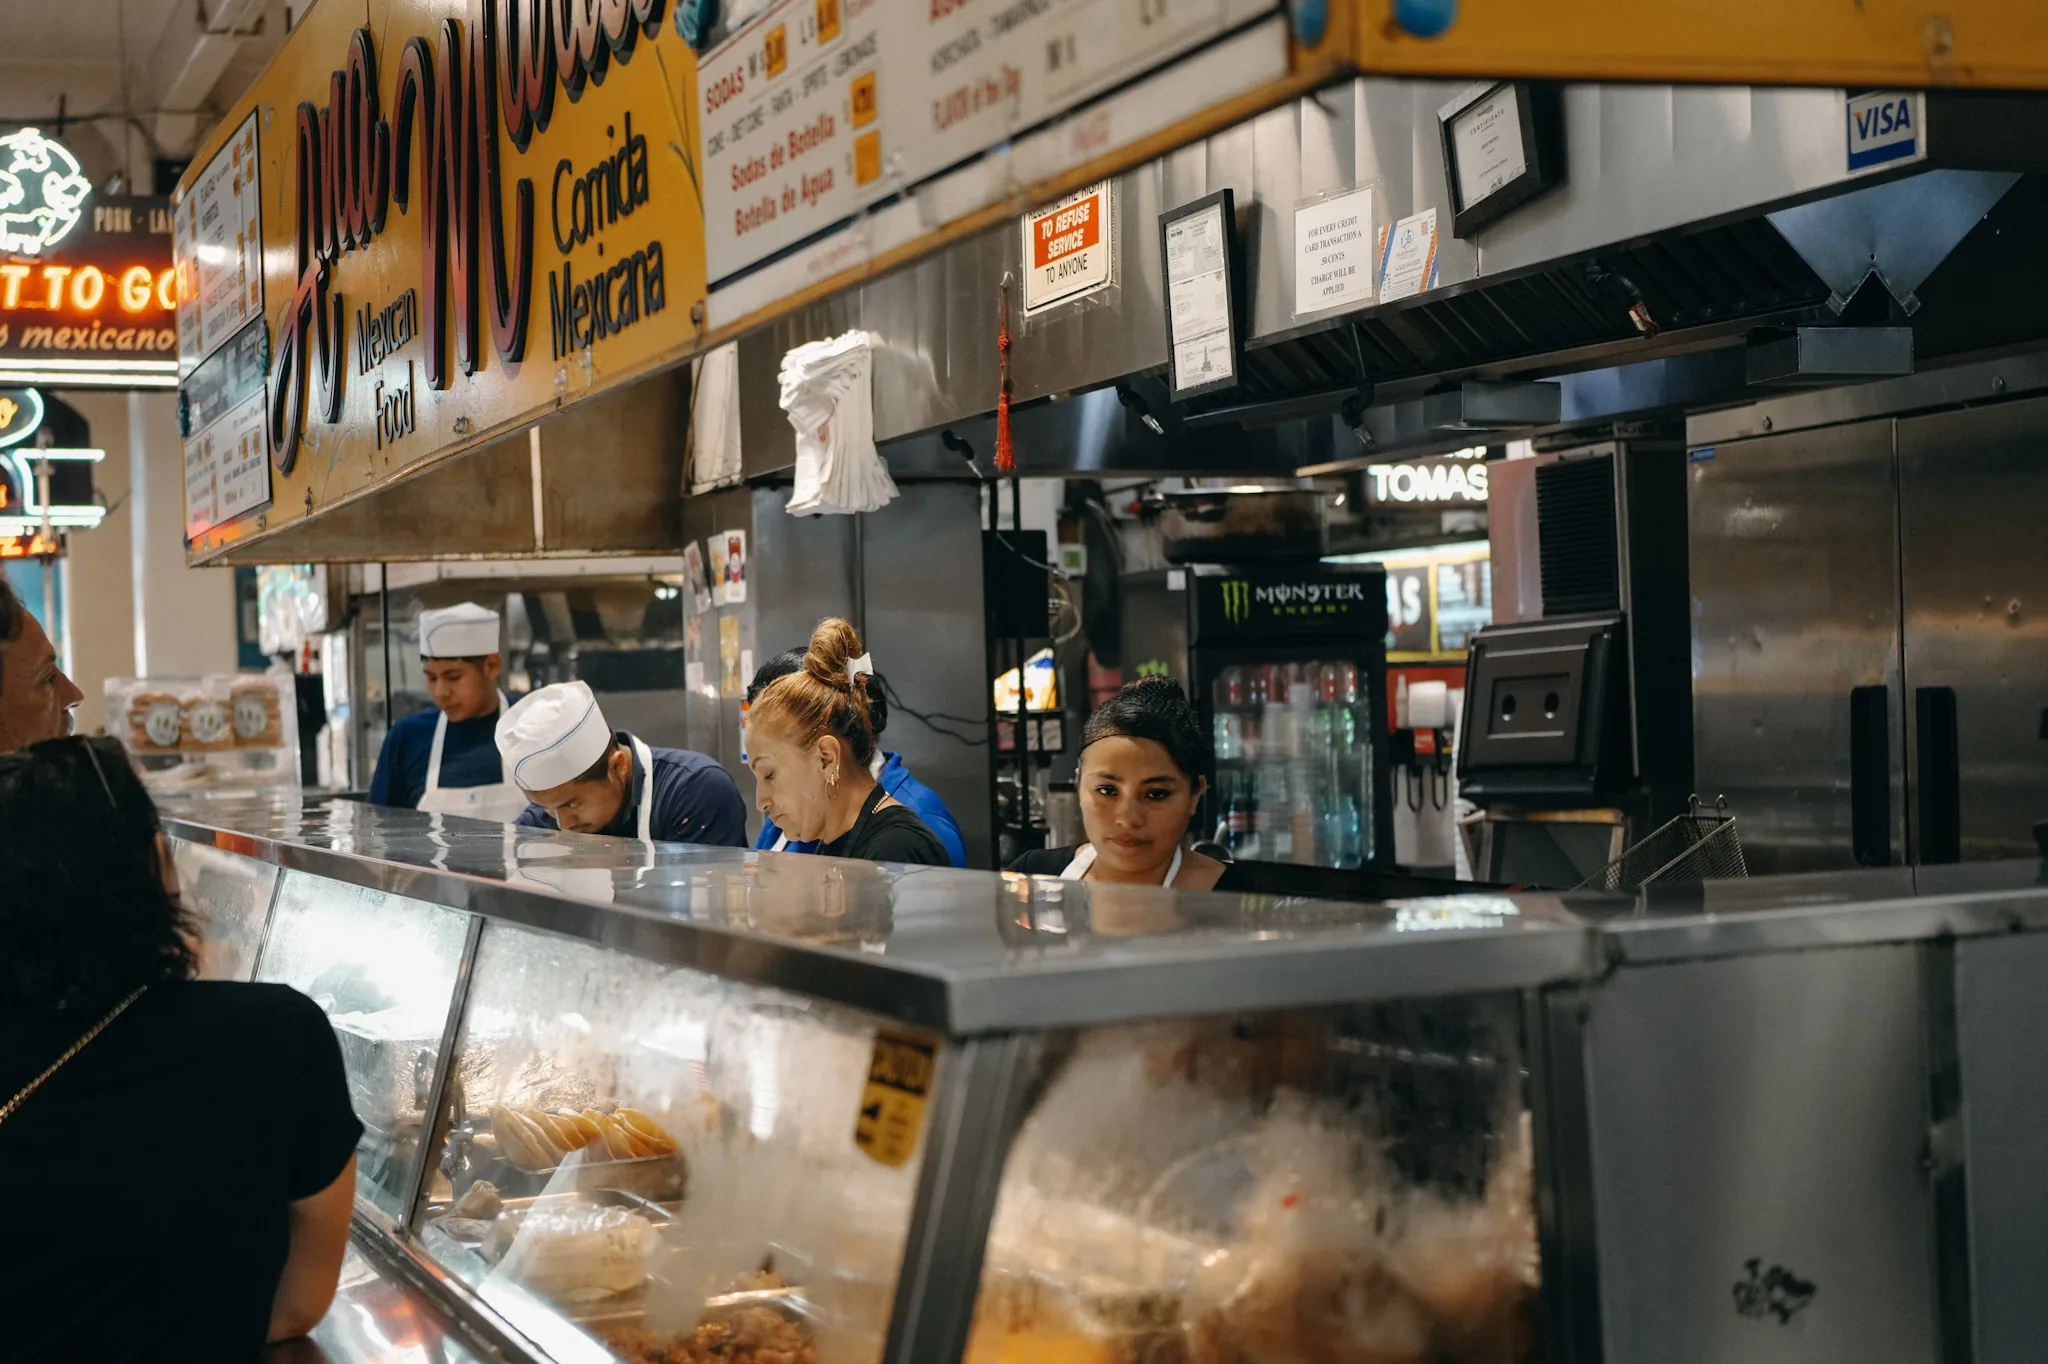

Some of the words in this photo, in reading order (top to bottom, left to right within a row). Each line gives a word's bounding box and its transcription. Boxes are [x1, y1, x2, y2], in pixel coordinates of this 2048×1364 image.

[706, 65, 744, 115] SODAS
[1853, 98, 1910, 140] VISA
[731, 156, 767, 192] Sodas
[770, 139, 785, 170] de
[788, 113, 835, 160] Botella
[551, 110, 649, 254] Comida
[735, 197, 776, 237] Botella
[782, 183, 796, 213] de
[802, 168, 834, 207] Agua
[1041, 219, 1053, 240] TO
[1055, 202, 1091, 234] REFUSE
[1047, 228, 1084, 260] SERVICE
[1304, 242, 1319, 254] CARD
[1320, 231, 1357, 249] TRANSACTION
[1308, 228, 1319, 239] FOR
[1319, 222, 1337, 235] EVERY
[1338, 216, 1358, 230] CREDIT
[1046, 266, 1055, 284] TO
[1058, 253, 1087, 280] ANYONE
[1311, 271, 1332, 285] CHARGE
[1333, 267, 1347, 278] WILL
[1348, 265, 1356, 275] BE
[1328, 251, 1345, 264] CENTS
[43, 265, 104, 310] TO
[549, 239, 666, 361] Mexicana
[1322, 282, 1345, 296] APPLIED
[356, 288, 417, 376] Mexican
[374, 360, 417, 450] Food
[1368, 464, 1489, 502] TOMAS
[1255, 581, 1363, 604] MONSTER
[1273, 605, 1348, 615] ENERGY
